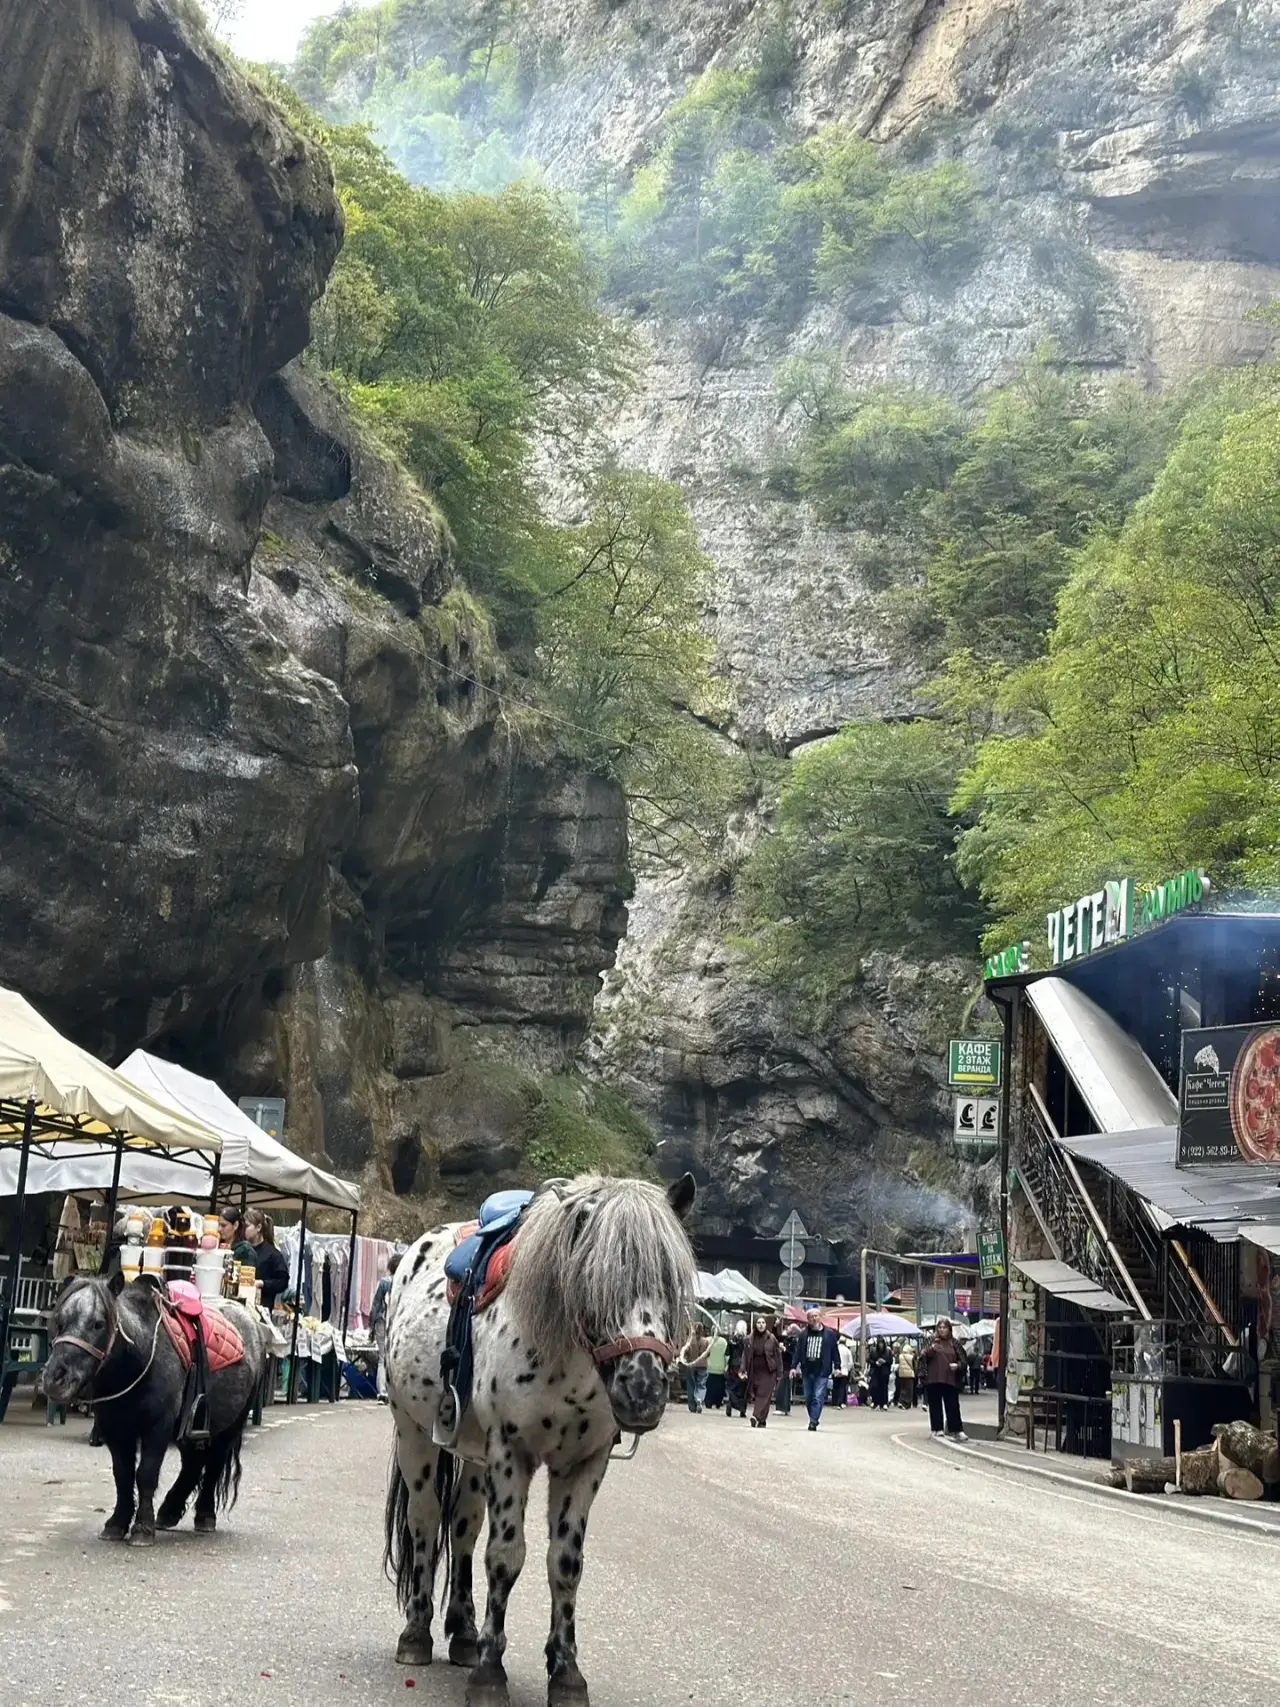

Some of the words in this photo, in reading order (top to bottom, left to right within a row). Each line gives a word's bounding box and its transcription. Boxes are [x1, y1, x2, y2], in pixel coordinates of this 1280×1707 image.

[1047, 878, 1134, 966] ЧЕГЕМ
[958, 1043, 992, 1055] КАФЕ
[958, 1056, 964, 1065] 2
[965, 1056, 991, 1065] ЭТАЖ
[957, 1065, 991, 1073] ВЕРАНДА
[1188, 1080, 1204, 1092] Кафе
[1181, 1146, 1186, 1156] 8
